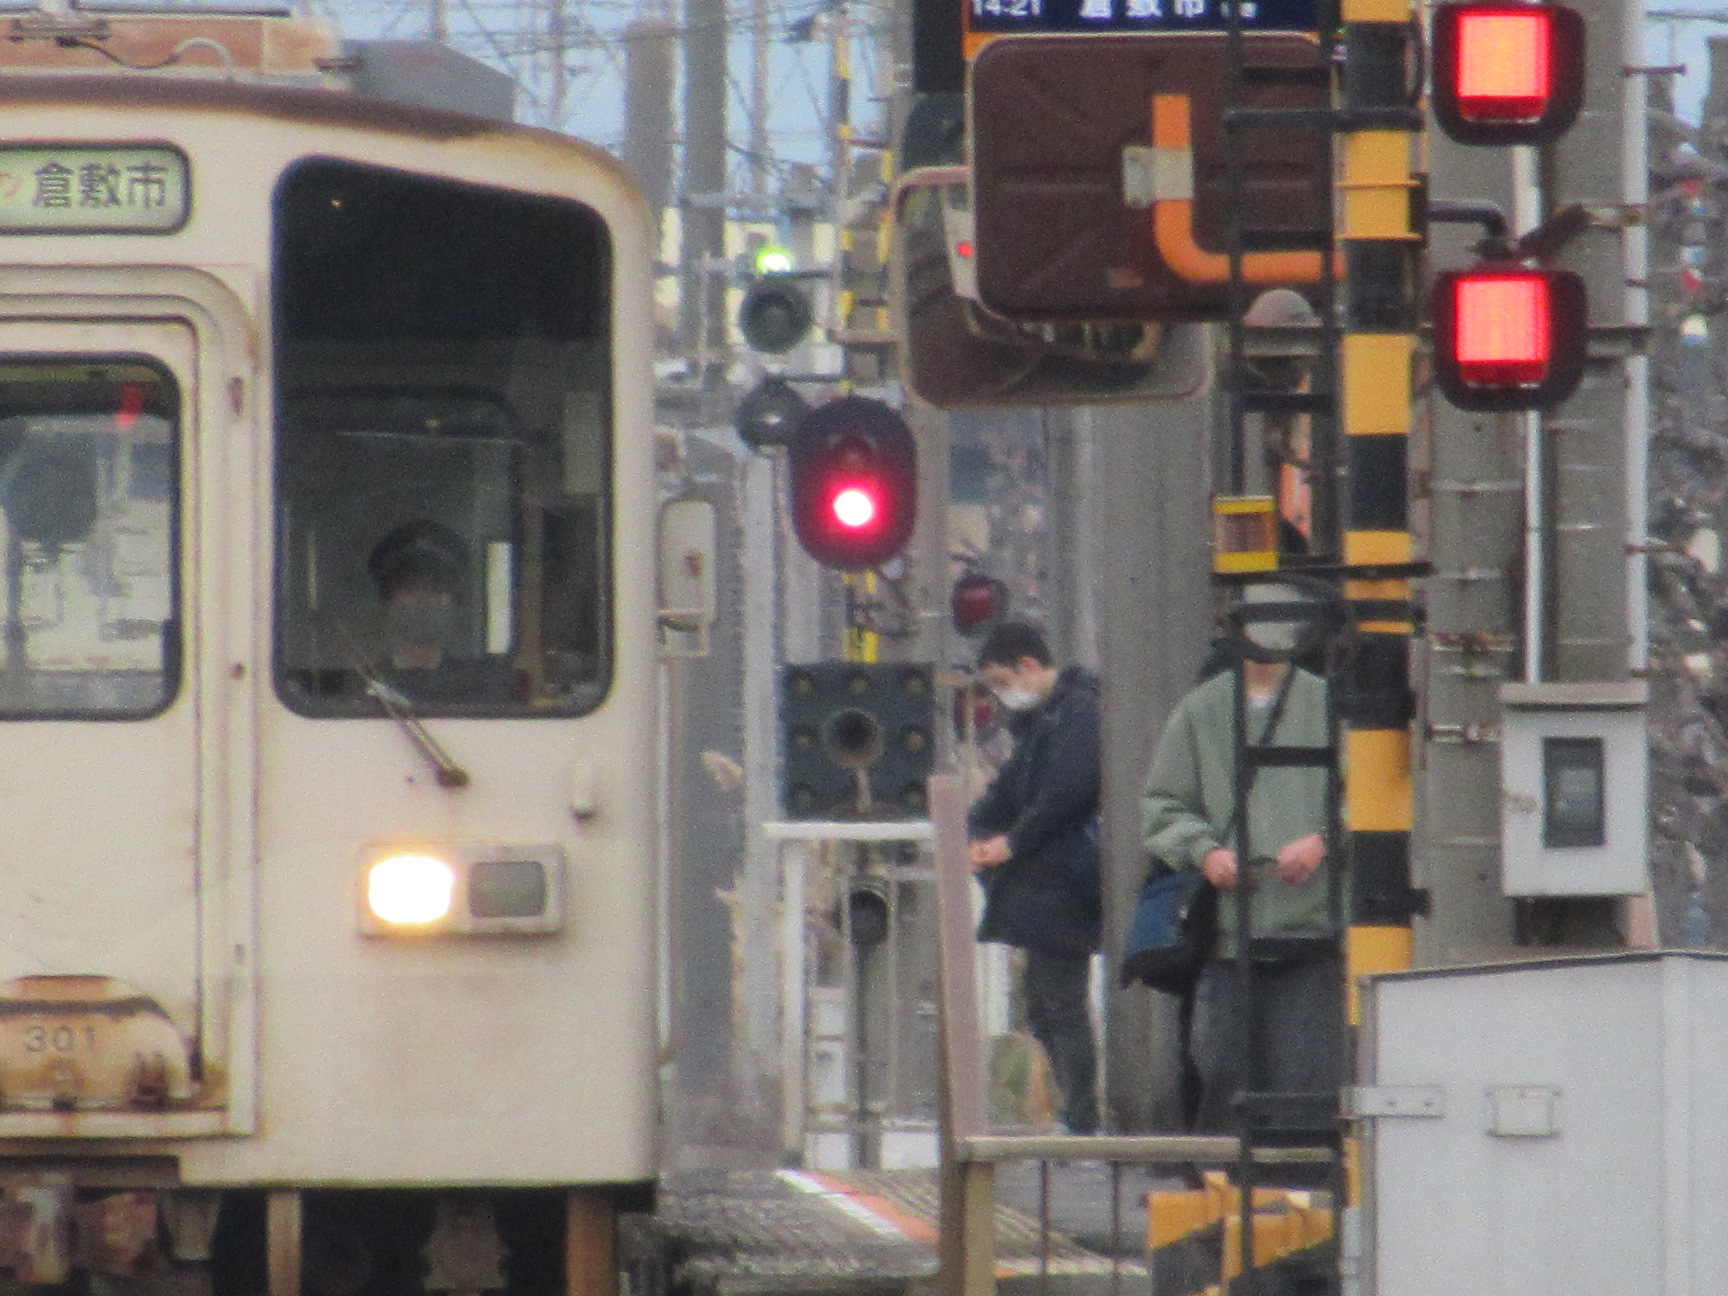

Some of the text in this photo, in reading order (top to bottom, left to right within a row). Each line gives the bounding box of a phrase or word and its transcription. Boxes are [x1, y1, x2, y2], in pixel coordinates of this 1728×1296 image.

[33, 161, 171, 209] 倉敷市
[26, 1025, 96, 1051] 301
